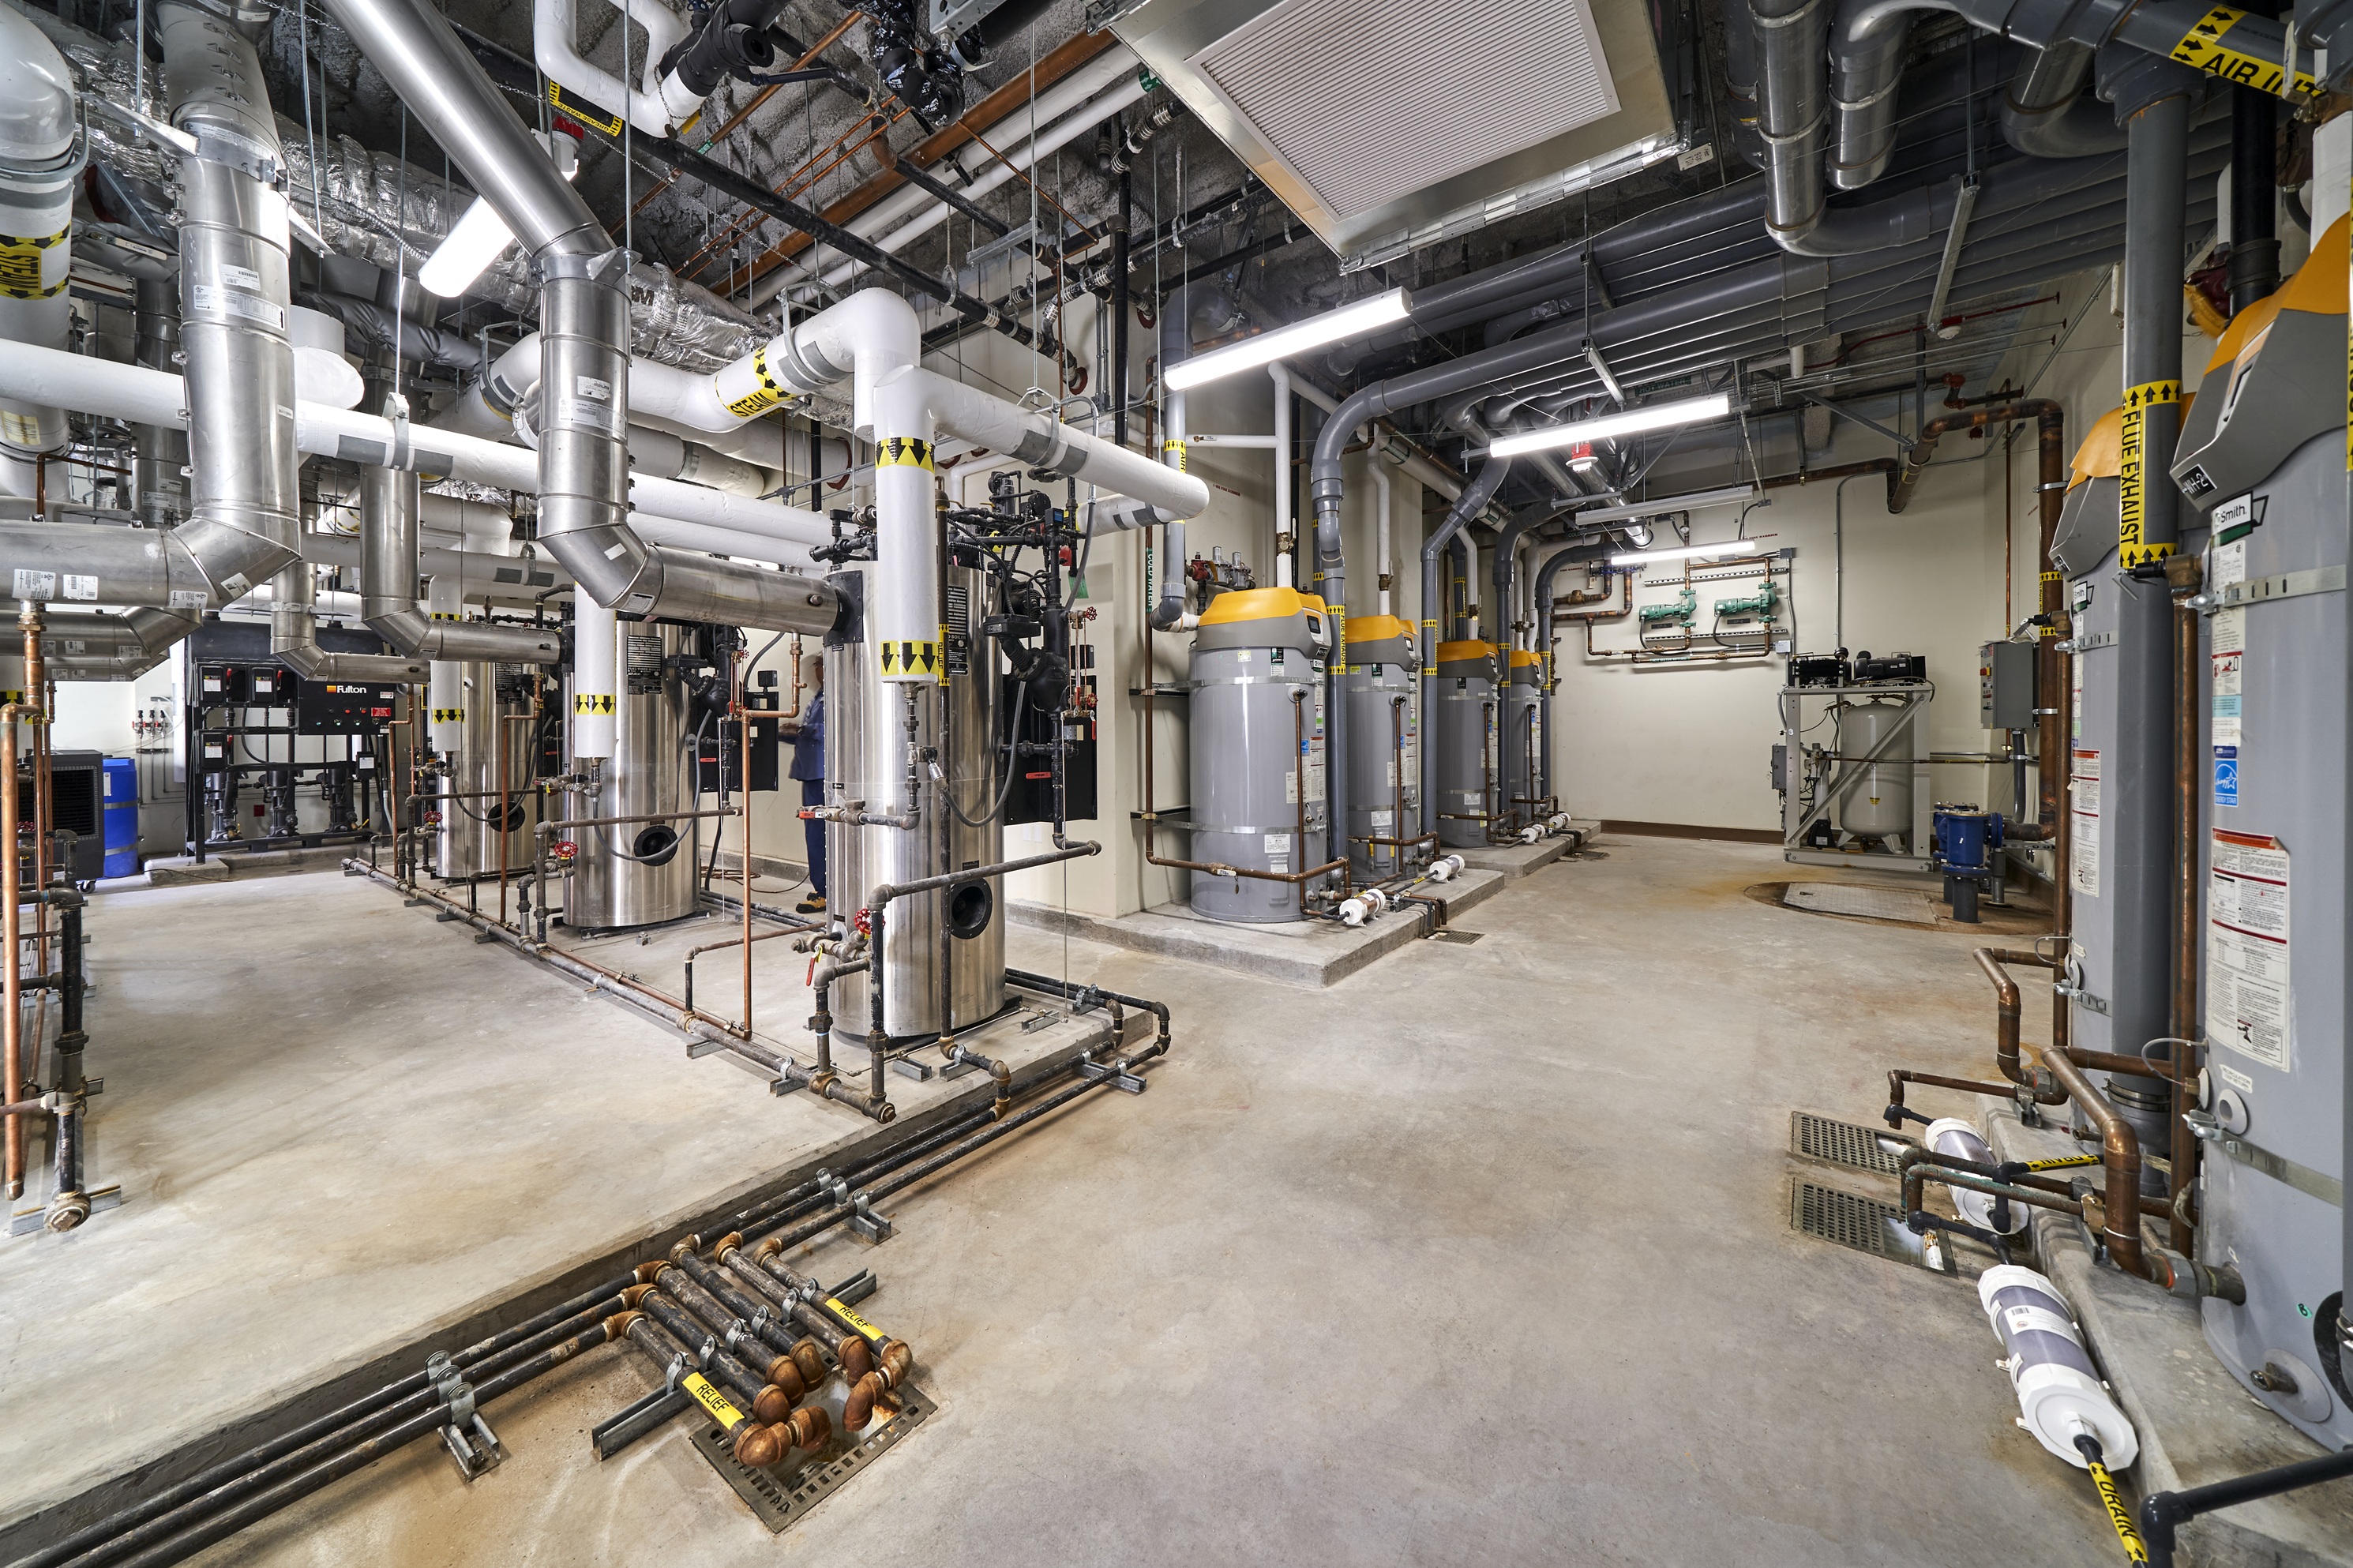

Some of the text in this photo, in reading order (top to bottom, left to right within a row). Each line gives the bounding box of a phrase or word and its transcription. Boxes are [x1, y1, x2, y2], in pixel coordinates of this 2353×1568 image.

[2201, 53, 2259, 84] AIR
[557, 103, 609, 132] GREASE WASTE
[1657, 378, 1686, 389] WATER
[730, 392, 777, 417] STEAM
[2120, 410, 2141, 545] FLUE EXHAUST
[2182, 472, 2209, 494] WH-2
[2220, 505, 2246, 523] Smith
[337, 685, 366, 694] Fulton
[839, 1306, 871, 1328] RELIEF
[696, 1383, 730, 1412] RELIEF
[2099, 1480, 2141, 1541] DRAIN
